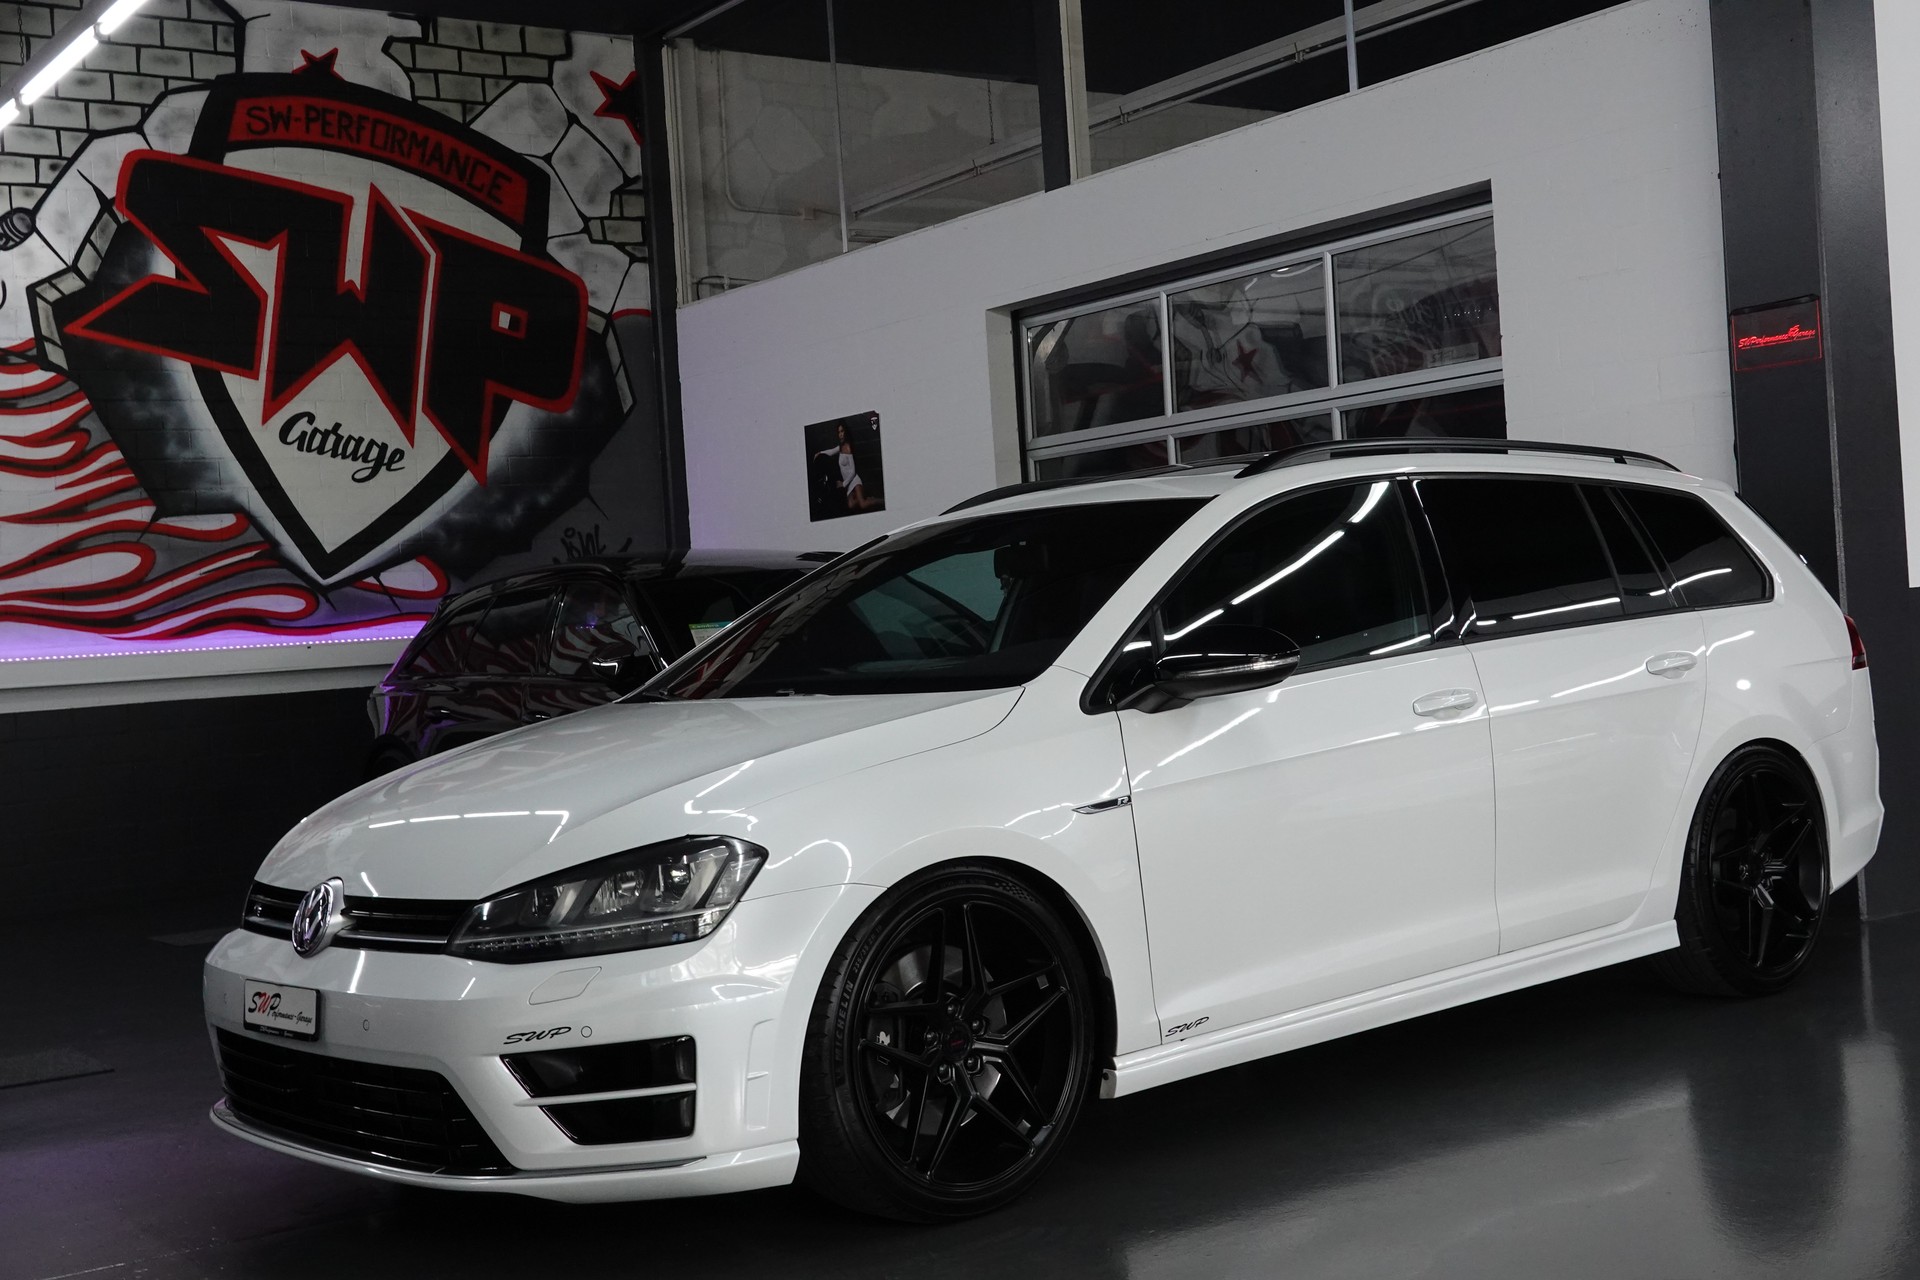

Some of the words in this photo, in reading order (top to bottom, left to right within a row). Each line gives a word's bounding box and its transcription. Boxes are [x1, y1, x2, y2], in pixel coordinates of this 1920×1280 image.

[246, 104, 513, 204] SW-PERFORMANCE
[63, 149, 589, 486] SWP
[279, 411, 405, 483] Garage
[503, 1026, 572, 1045] SWP
[834, 980, 854, 1062] MICHELIN
[1165, 1016, 1210, 1037] SWP
